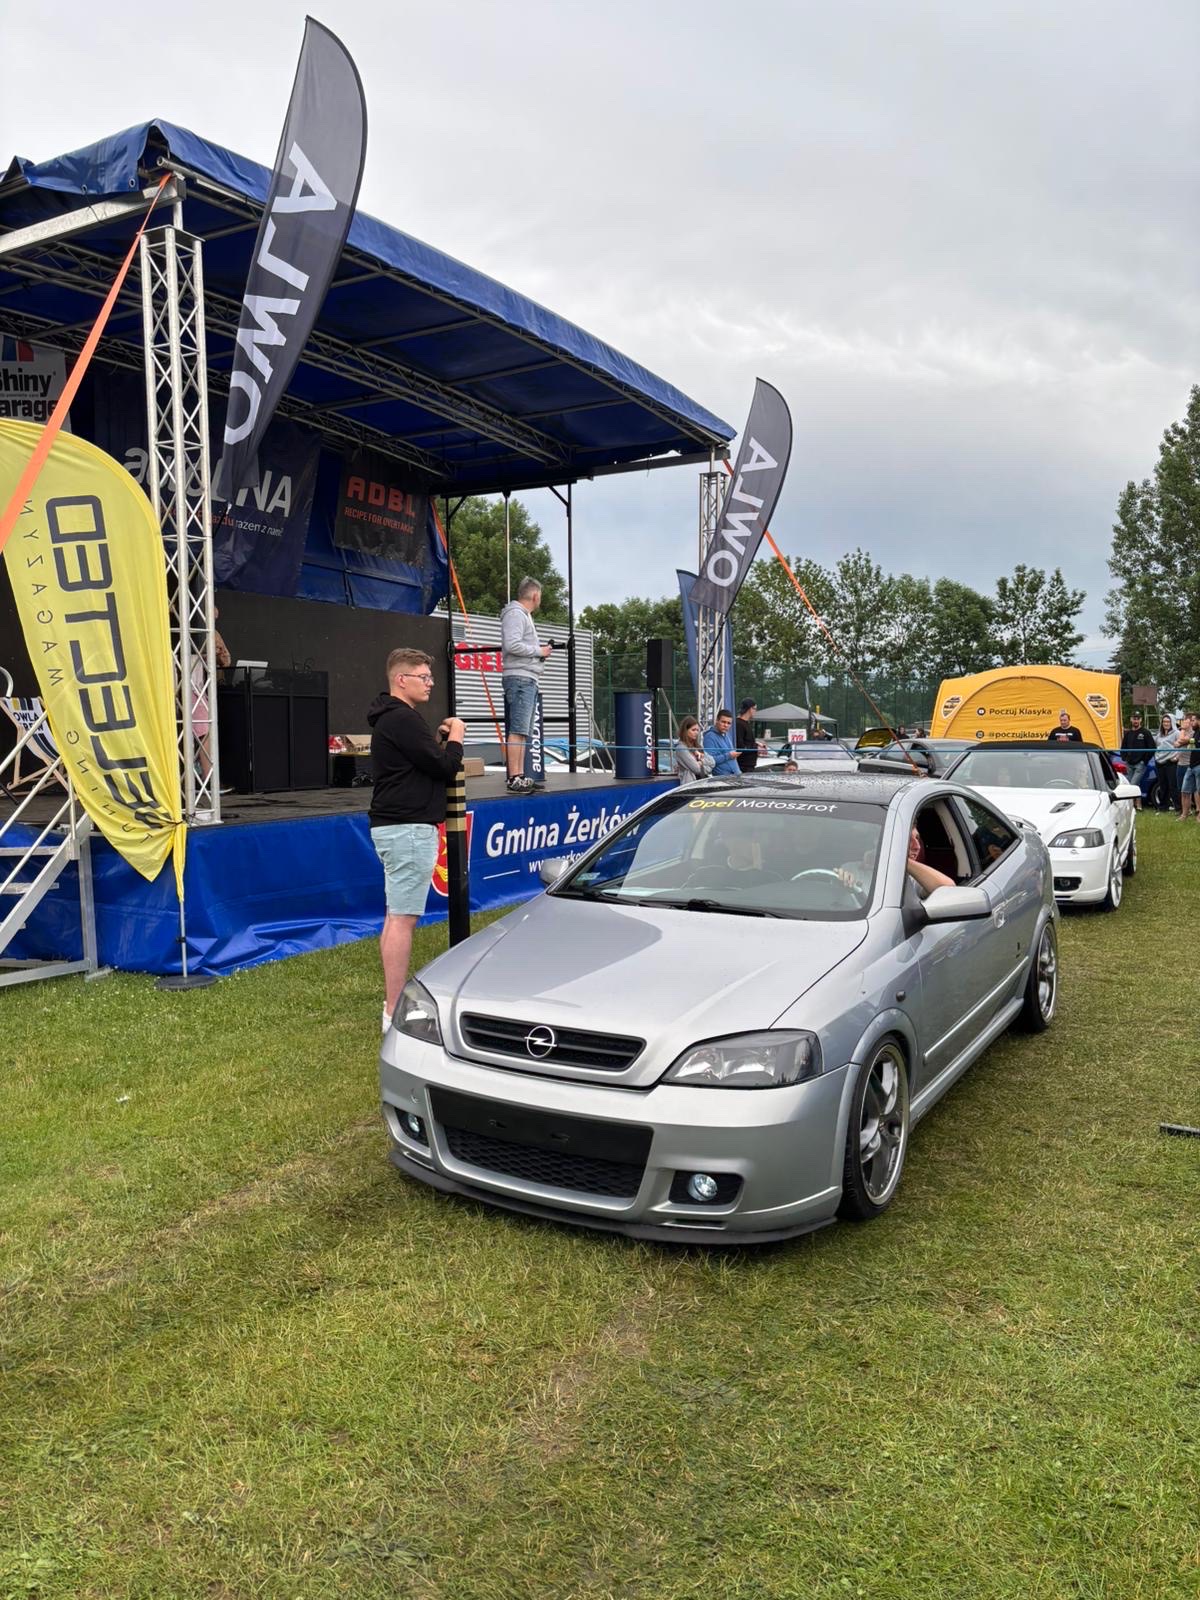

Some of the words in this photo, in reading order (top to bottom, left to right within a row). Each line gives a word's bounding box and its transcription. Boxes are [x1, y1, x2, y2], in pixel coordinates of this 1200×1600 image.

[0, 367, 52, 397] hiny
[346, 475, 416, 518] ADBL
[989, 708, 1017, 716] Poczuj
[1018, 707, 1052, 716] Klasyka
[988, 731, 1050, 739] @poczujklasyk
[687, 799, 735, 810] Opel
[736, 799, 838, 812] Motoszrot
[485, 816, 560, 858] Gmina
